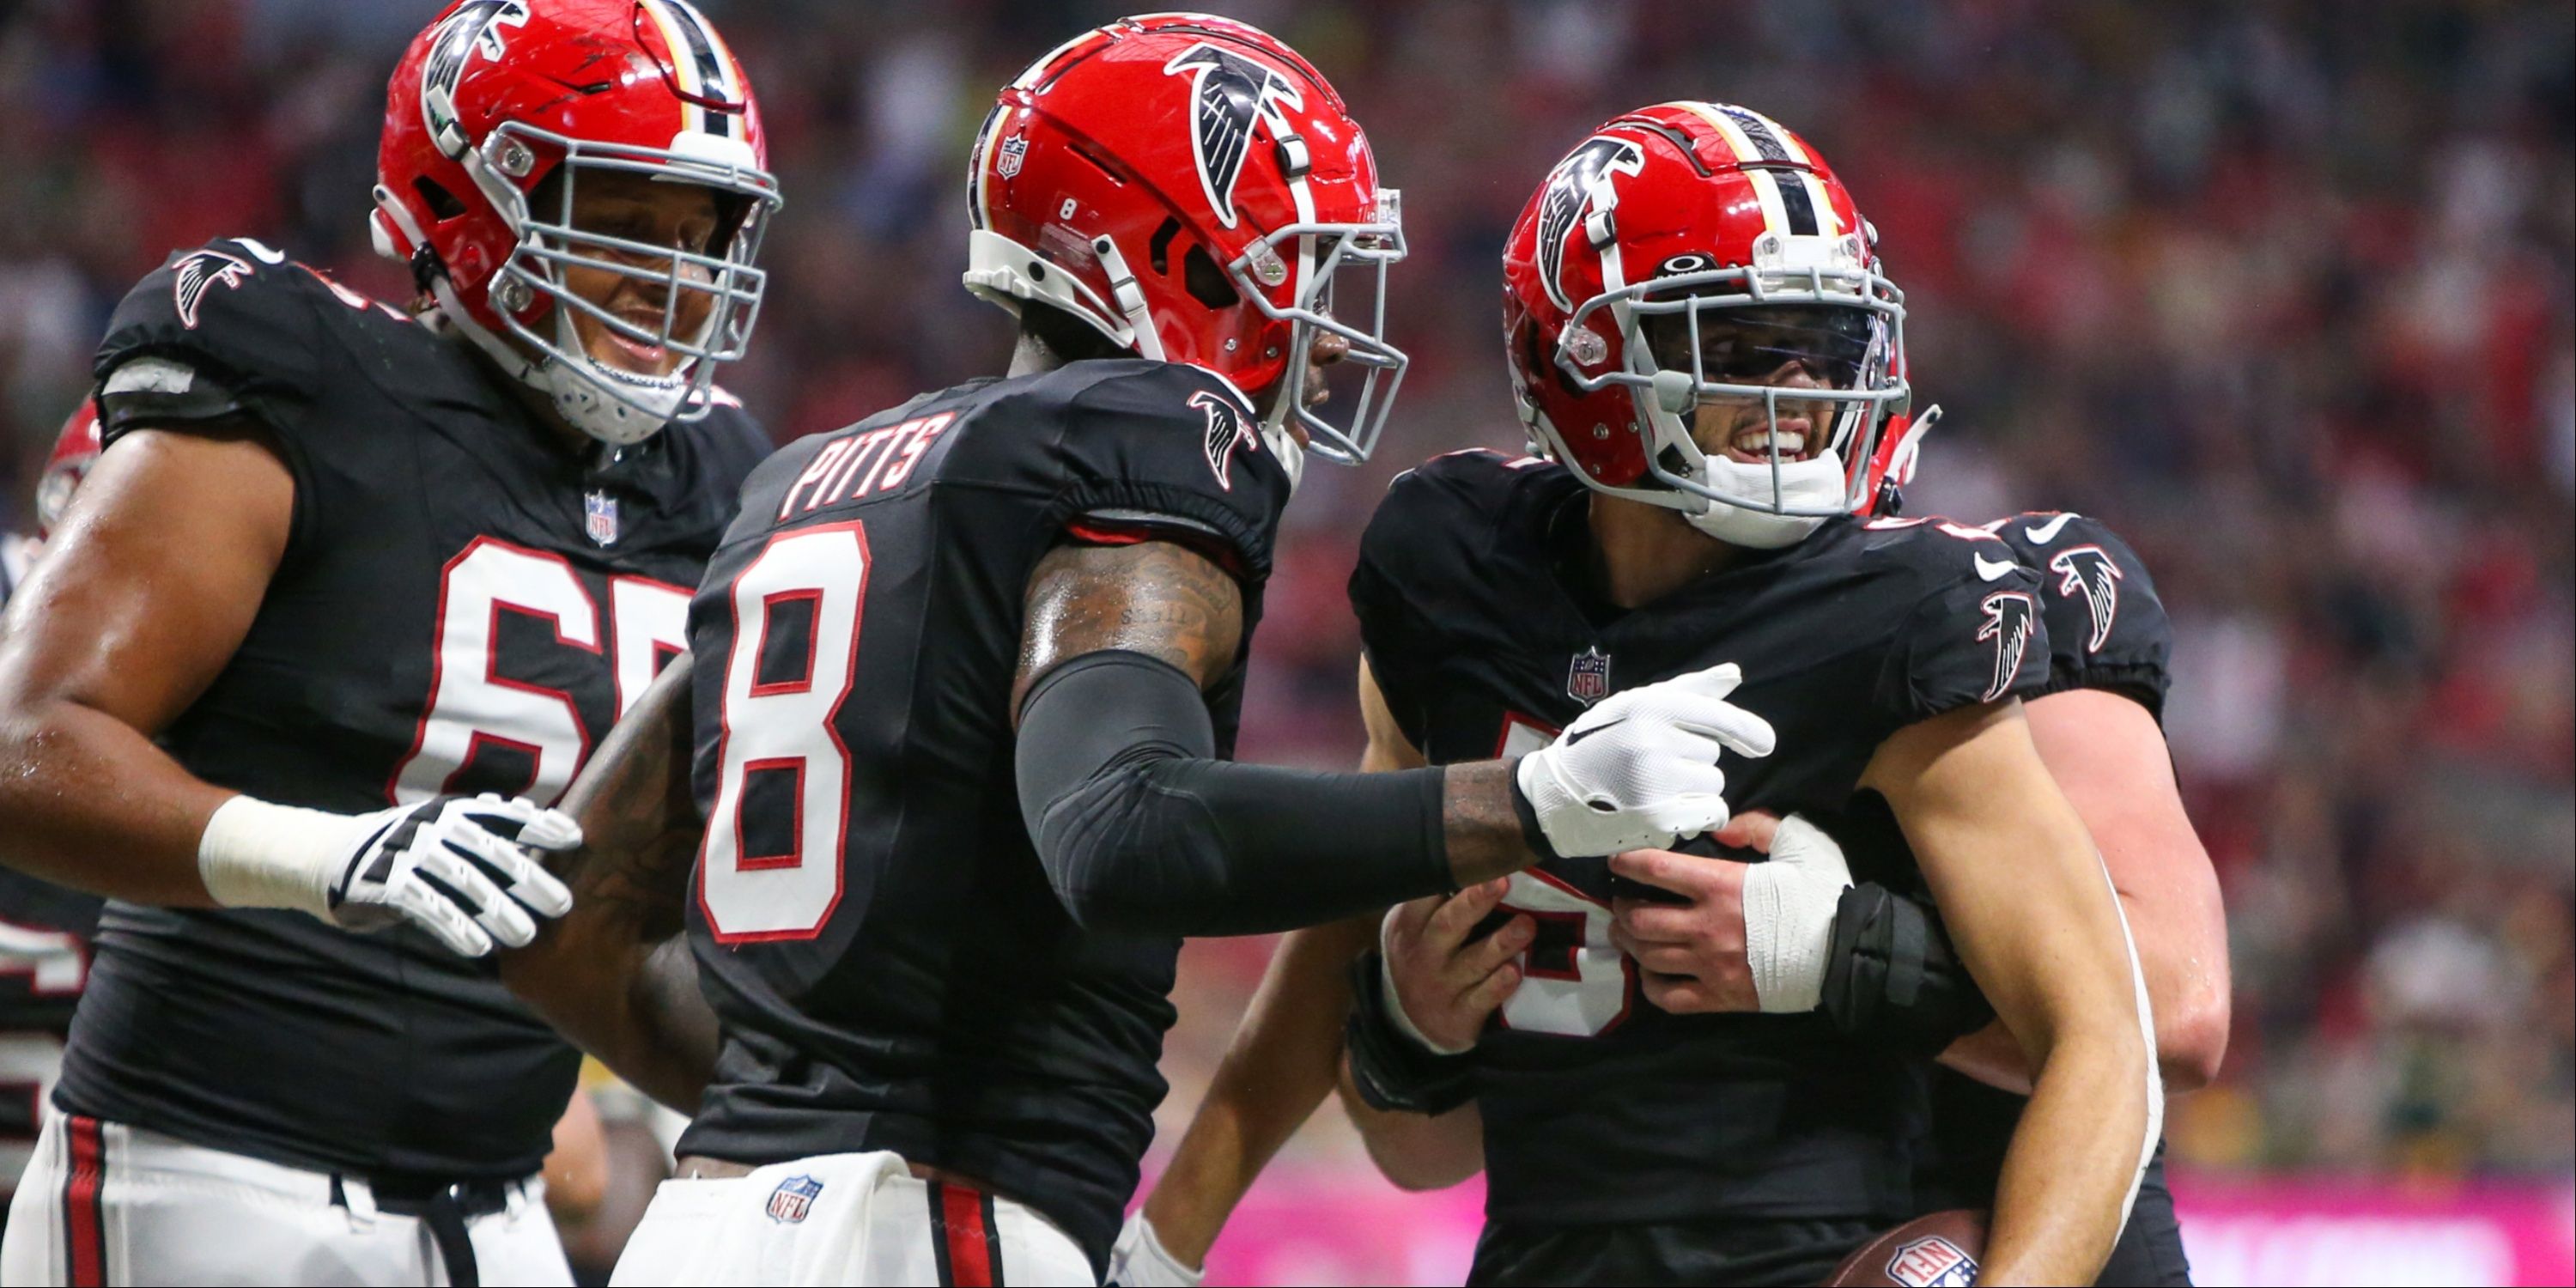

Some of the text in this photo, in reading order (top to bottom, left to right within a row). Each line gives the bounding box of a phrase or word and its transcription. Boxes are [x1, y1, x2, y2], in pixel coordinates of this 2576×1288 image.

[999, 154, 1018, 172] NFL
[1059, 197, 1078, 221] 8
[778, 410, 957, 522] PITTS
[590, 514, 613, 537] NFL
[1573, 673, 1603, 696] NFL
[696, 519, 872, 945] 8
[770, 1191, 805, 1219] NFL
[1894, 1241, 1959, 1284] NFL
